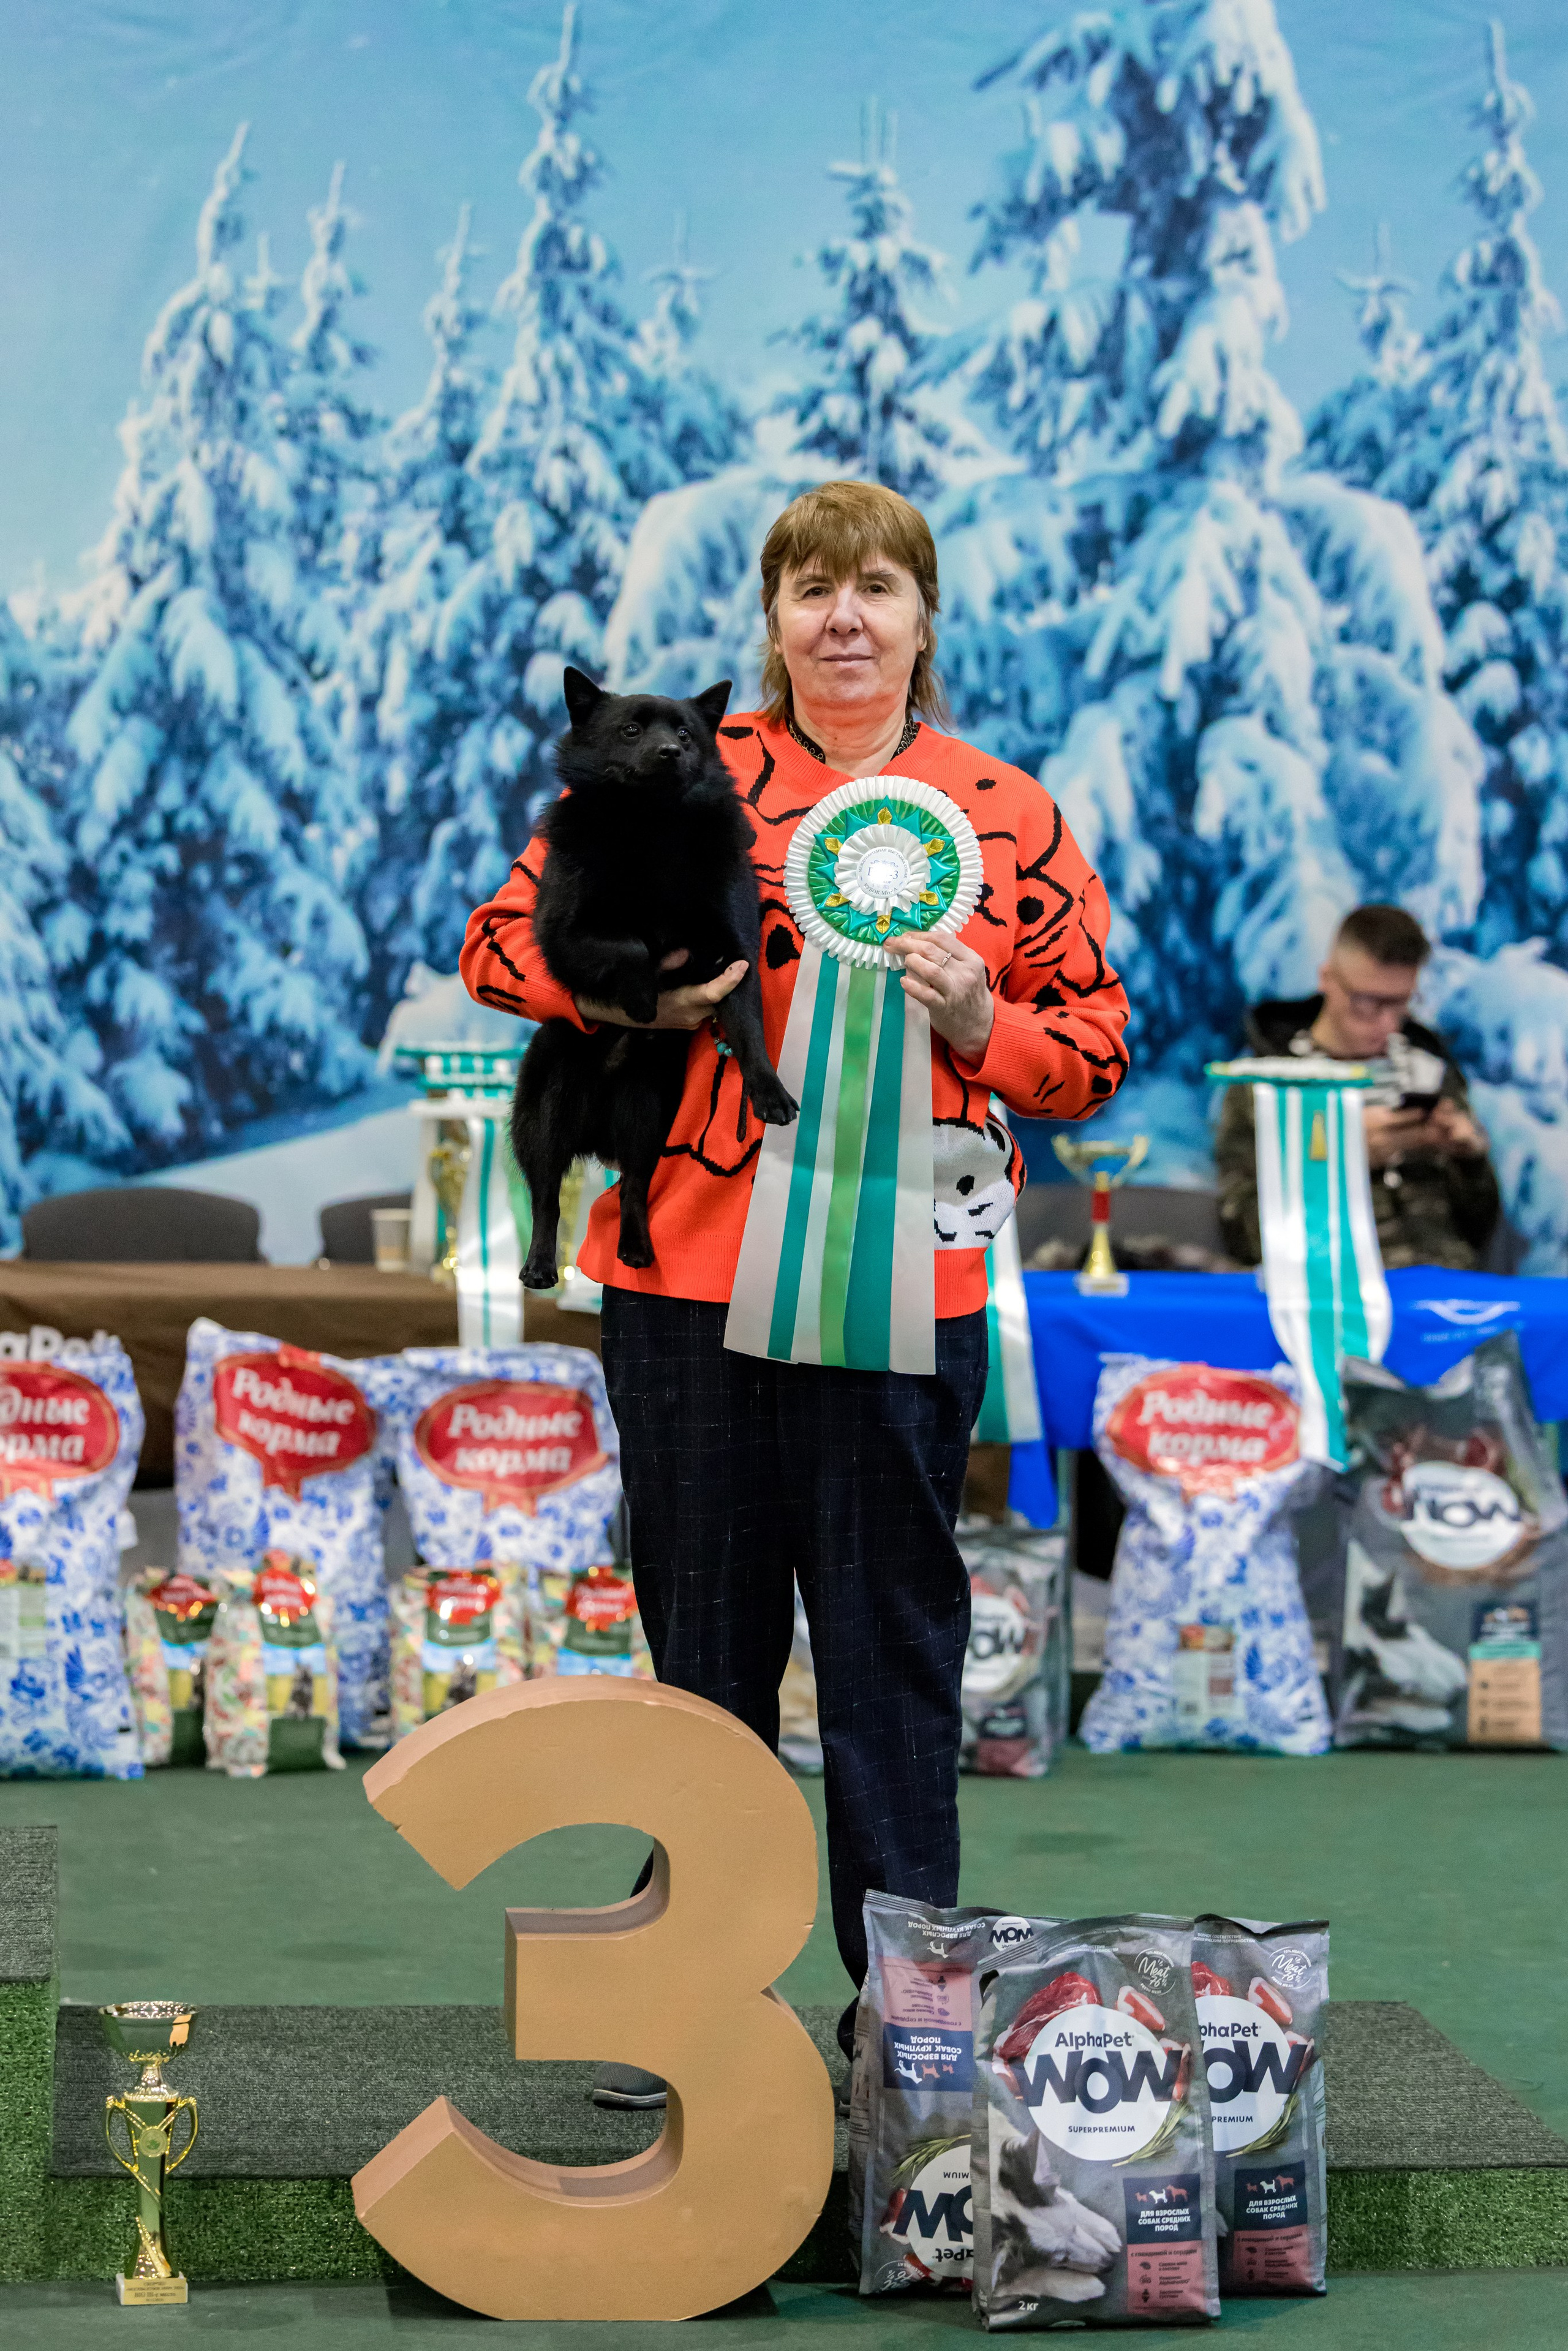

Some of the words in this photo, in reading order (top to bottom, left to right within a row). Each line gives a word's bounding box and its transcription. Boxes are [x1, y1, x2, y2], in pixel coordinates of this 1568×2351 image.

[859, 849, 886, 872] МЕЖДУНАРОДНАЯ
[888, 849, 906, 864] ВЫСТАВКА
[864, 883, 880, 895] КУБОК
[232, 1367, 356, 1425] Родные
[1136, 1388, 1274, 1429] Родные
[448, 1403, 582, 1441] Родные
[238, 1409, 341, 1457] корма
[1148, 1431, 1267, 1466] корма
[455, 1446, 573, 1478] корма
[908, 1921, 931, 1931] ПОРОД
[922, 1930, 958, 1939] ВЗРОСЛЫХ
[964, 1922, 986, 1931] СОБАК
[988, 1926, 1035, 1943] WOW
[1138, 1957, 1171, 1978] Meat
[1272, 1954, 1307, 1976] Meat
[1149, 1976, 1167, 1987] 76%
[1281, 1971, 1301, 1983] 76%
[351, 1674, 835, 2322] 3
[894, 2042, 932, 2052] КРУПНЫХ
[1055, 2031, 1133, 2050] AlphaPet
[897, 2050, 940, 2060] ВЗРОСЛЫХ
[935, 2045, 962, 2054] СОБАК
[1202, 2040, 1309, 2104] OW
[1015, 2050, 1184, 2114] WOW
[1264, 2195, 1297, 2205] ВЗРОСЛЫХ
[1270, 2202, 1298, 2212] СРЕДНИХ
[1161, 2216, 1191, 2224] СРЕДНИХ
[1019, 2300, 1025, 2310] 2
